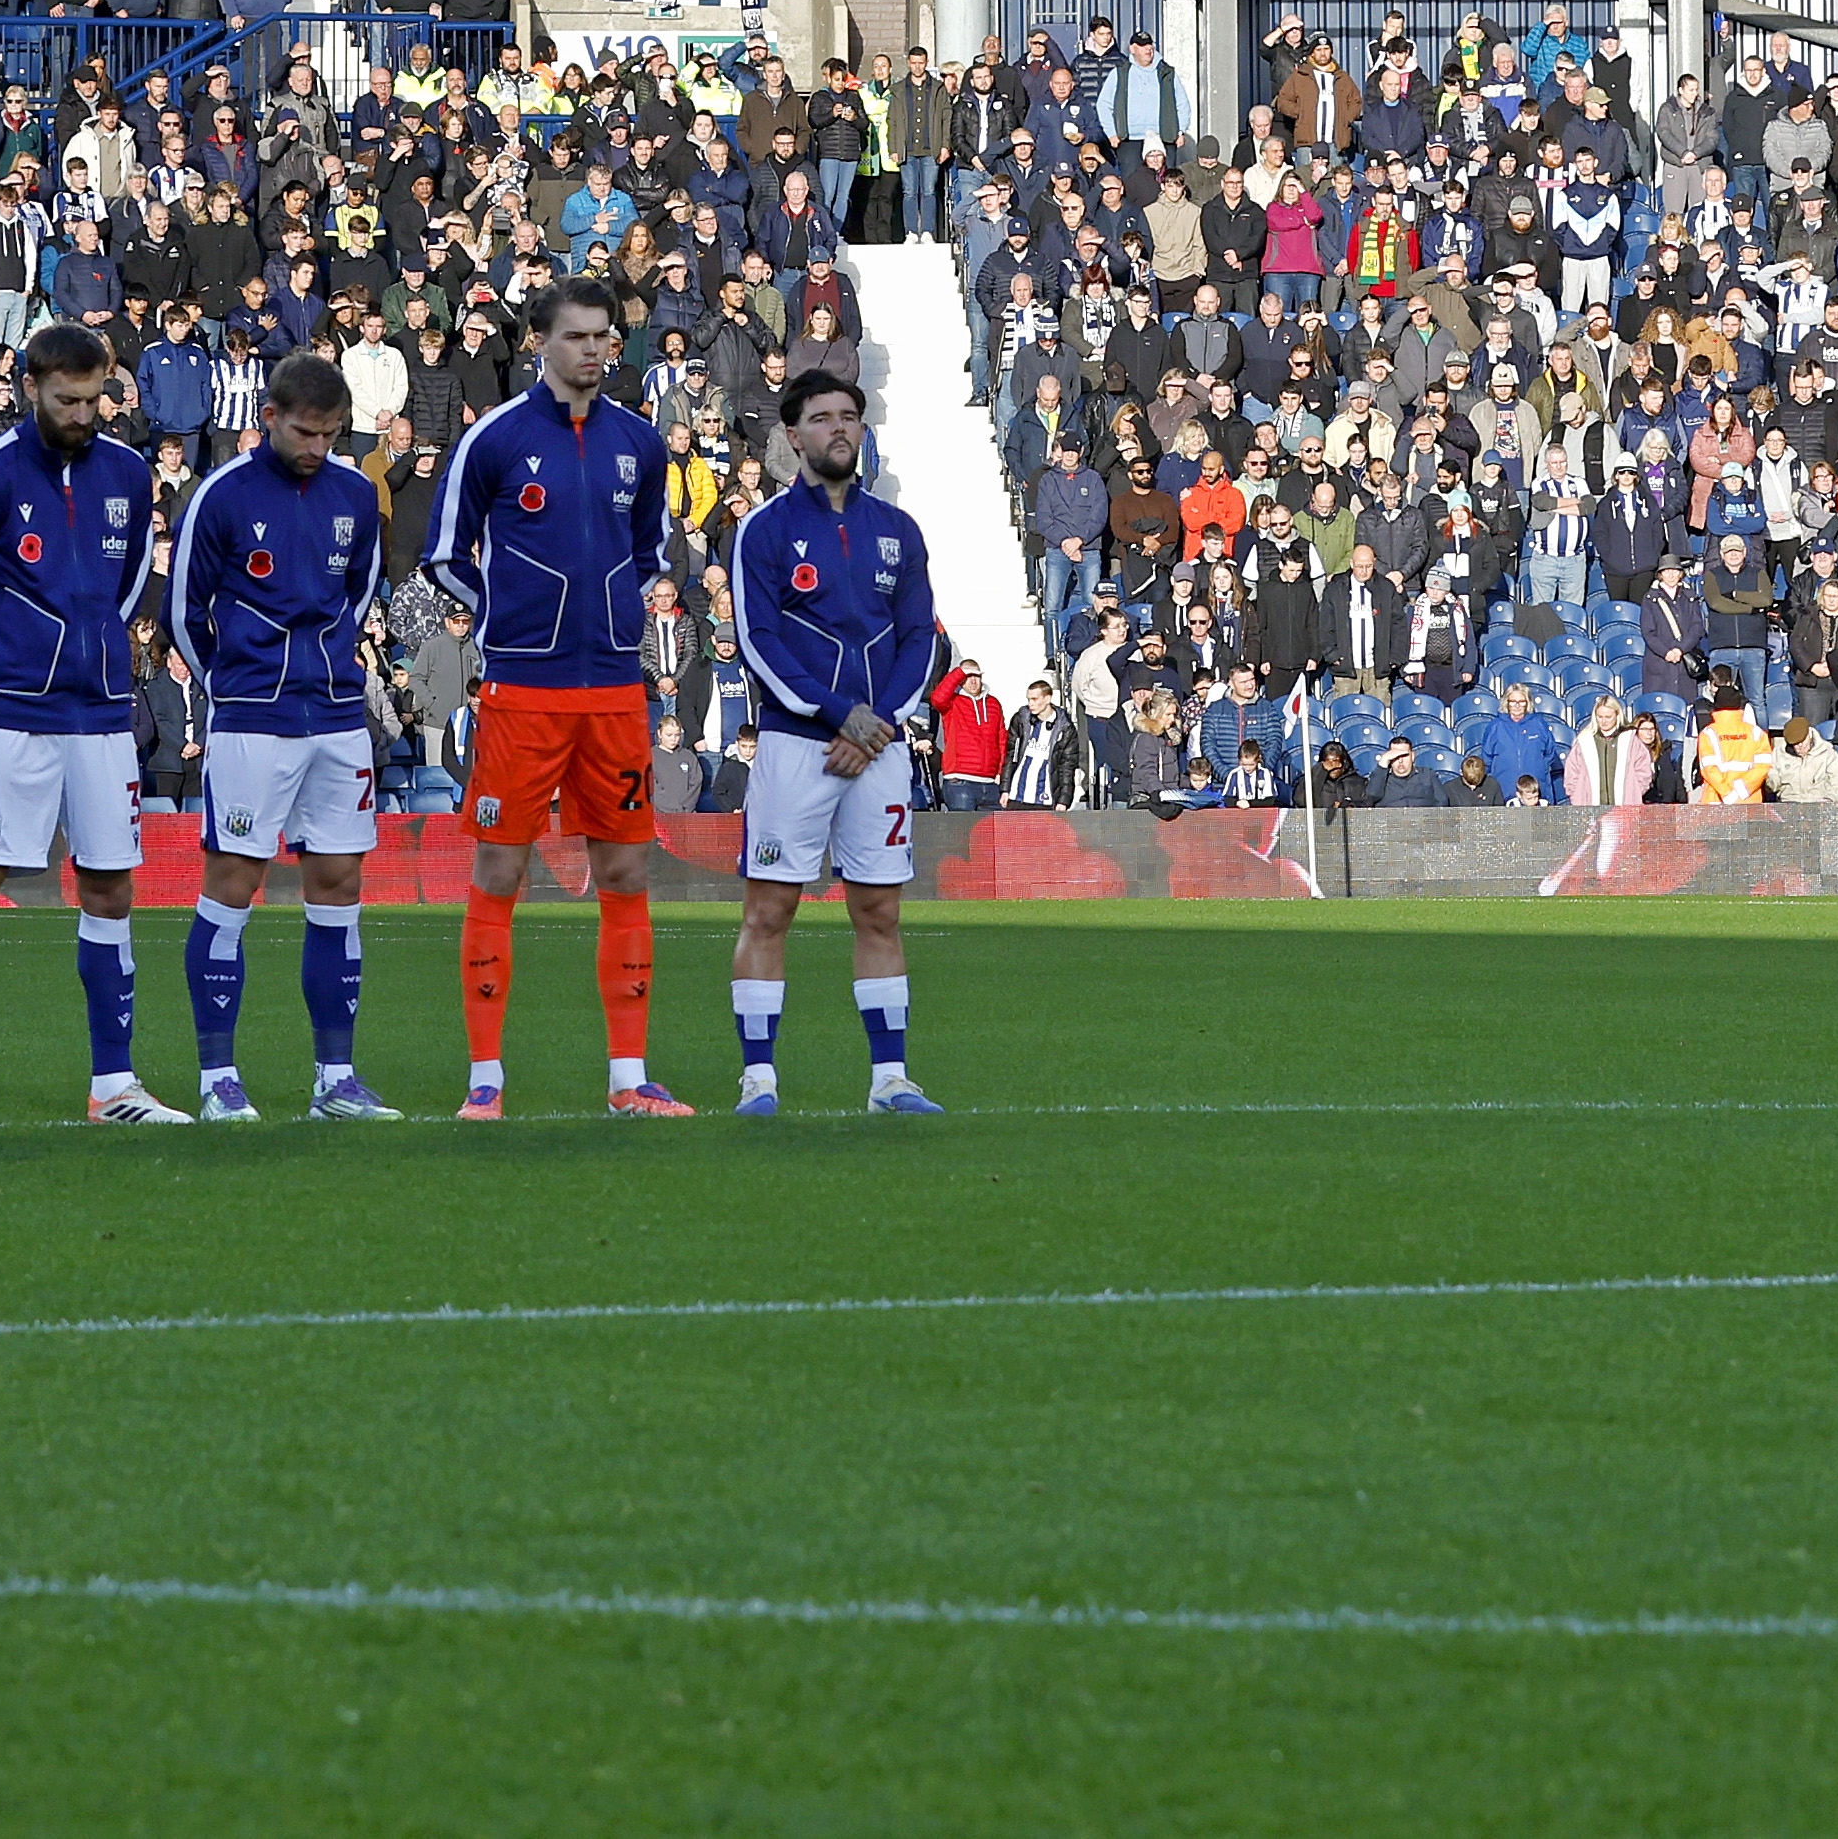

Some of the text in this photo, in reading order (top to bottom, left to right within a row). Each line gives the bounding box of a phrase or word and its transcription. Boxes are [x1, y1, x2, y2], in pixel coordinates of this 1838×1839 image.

[719, 680, 745, 692] ideal
[885, 802, 912, 846] 2
[203, 973, 237, 982] WBA
